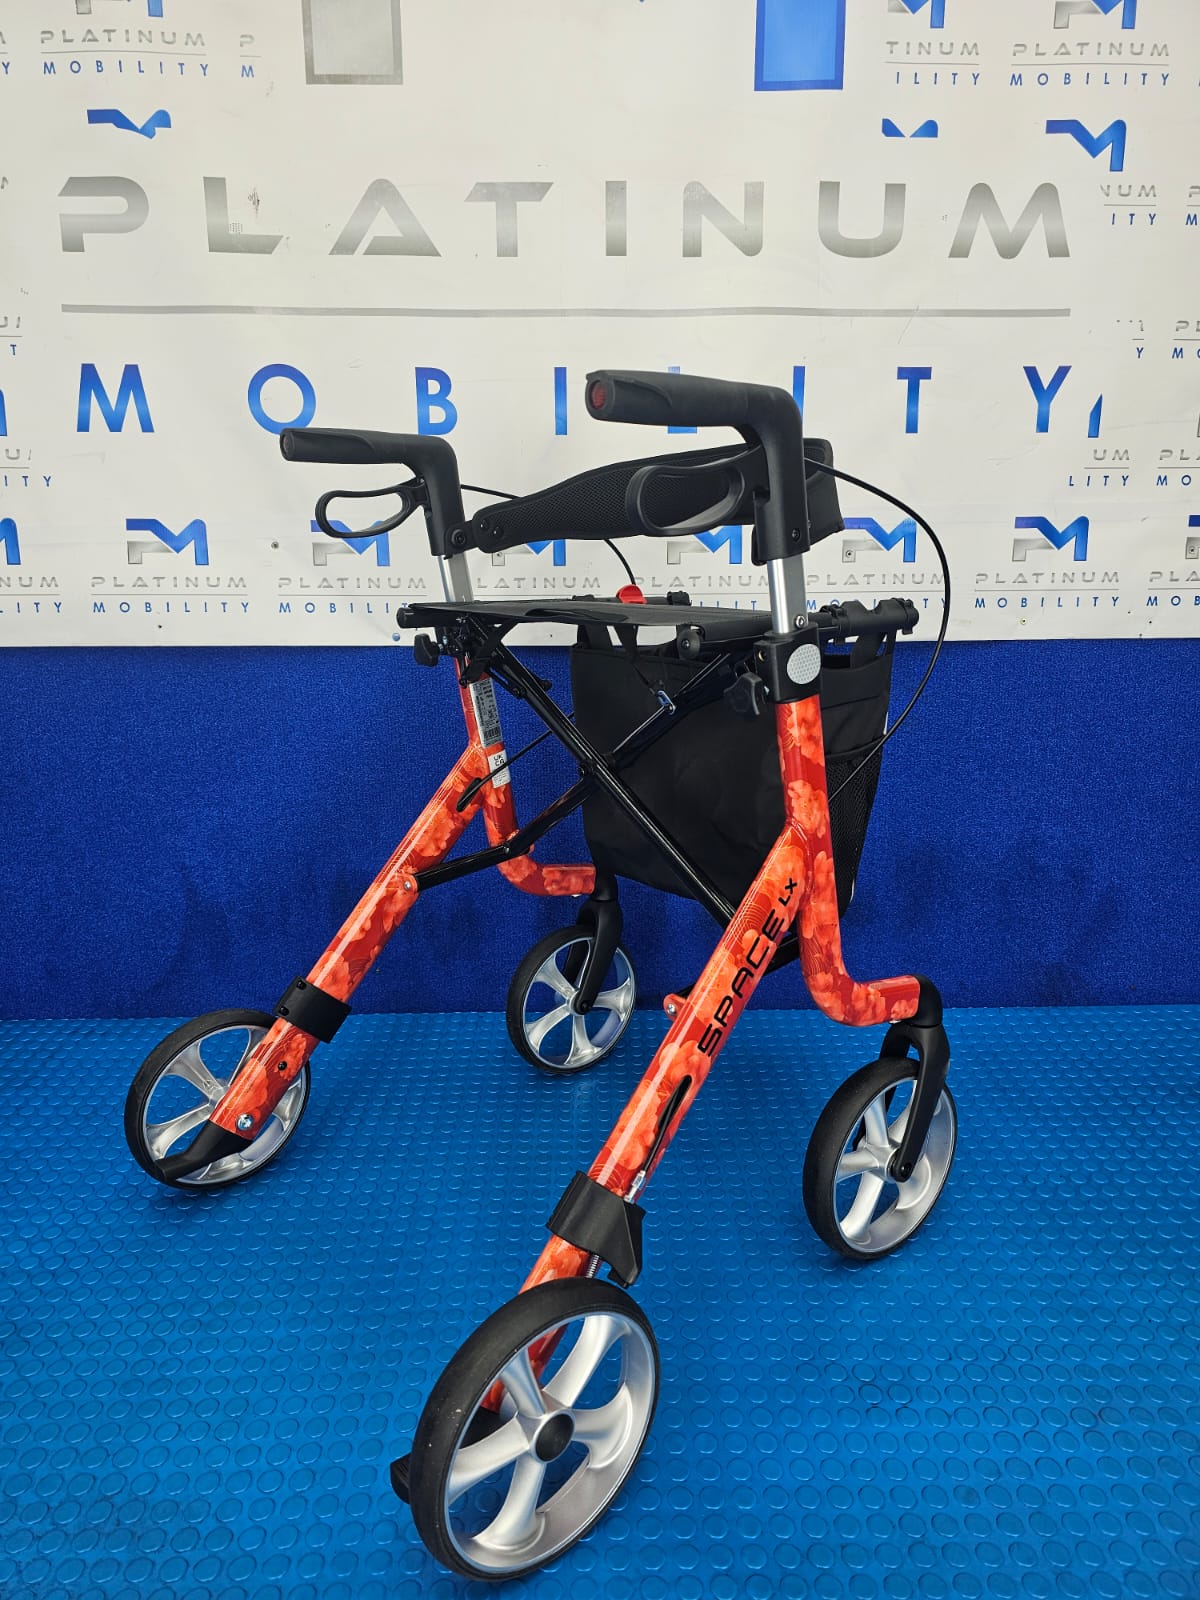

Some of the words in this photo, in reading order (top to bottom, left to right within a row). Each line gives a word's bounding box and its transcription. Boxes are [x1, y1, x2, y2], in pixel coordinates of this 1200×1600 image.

[41, 29, 204, 46] PLATINUM
[886, 41, 979, 55] TINUM
[1013, 42, 1169, 56] PLATINUM
[2, 61, 10, 75] Y
[44, 60, 208, 76] MOBILITY
[897, 72, 980, 85] ILITY
[1010, 72, 1169, 86] MOBILITY
[57, 177, 1070, 258] PLATINUM
[1112, 213, 1156, 225] ITY
[78, 363, 1071, 437] MOBIITY
[1094, 449, 1129, 461] UM
[1069, 474, 1129, 487] LITY
[1157, 475, 1191, 486] MO
[92, 577, 246, 588] PLATINUM
[279, 577, 426, 589] PLATINUM
[477, 577, 600, 588] LATINUM
[976, 572, 1119, 584] PLATINUM
[93, 602, 248, 614] MOBILITY
[975, 596, 1119, 608] MOBILITY
[697, 909, 785, 1057] SPACE
[778, 878, 798, 907] LX
